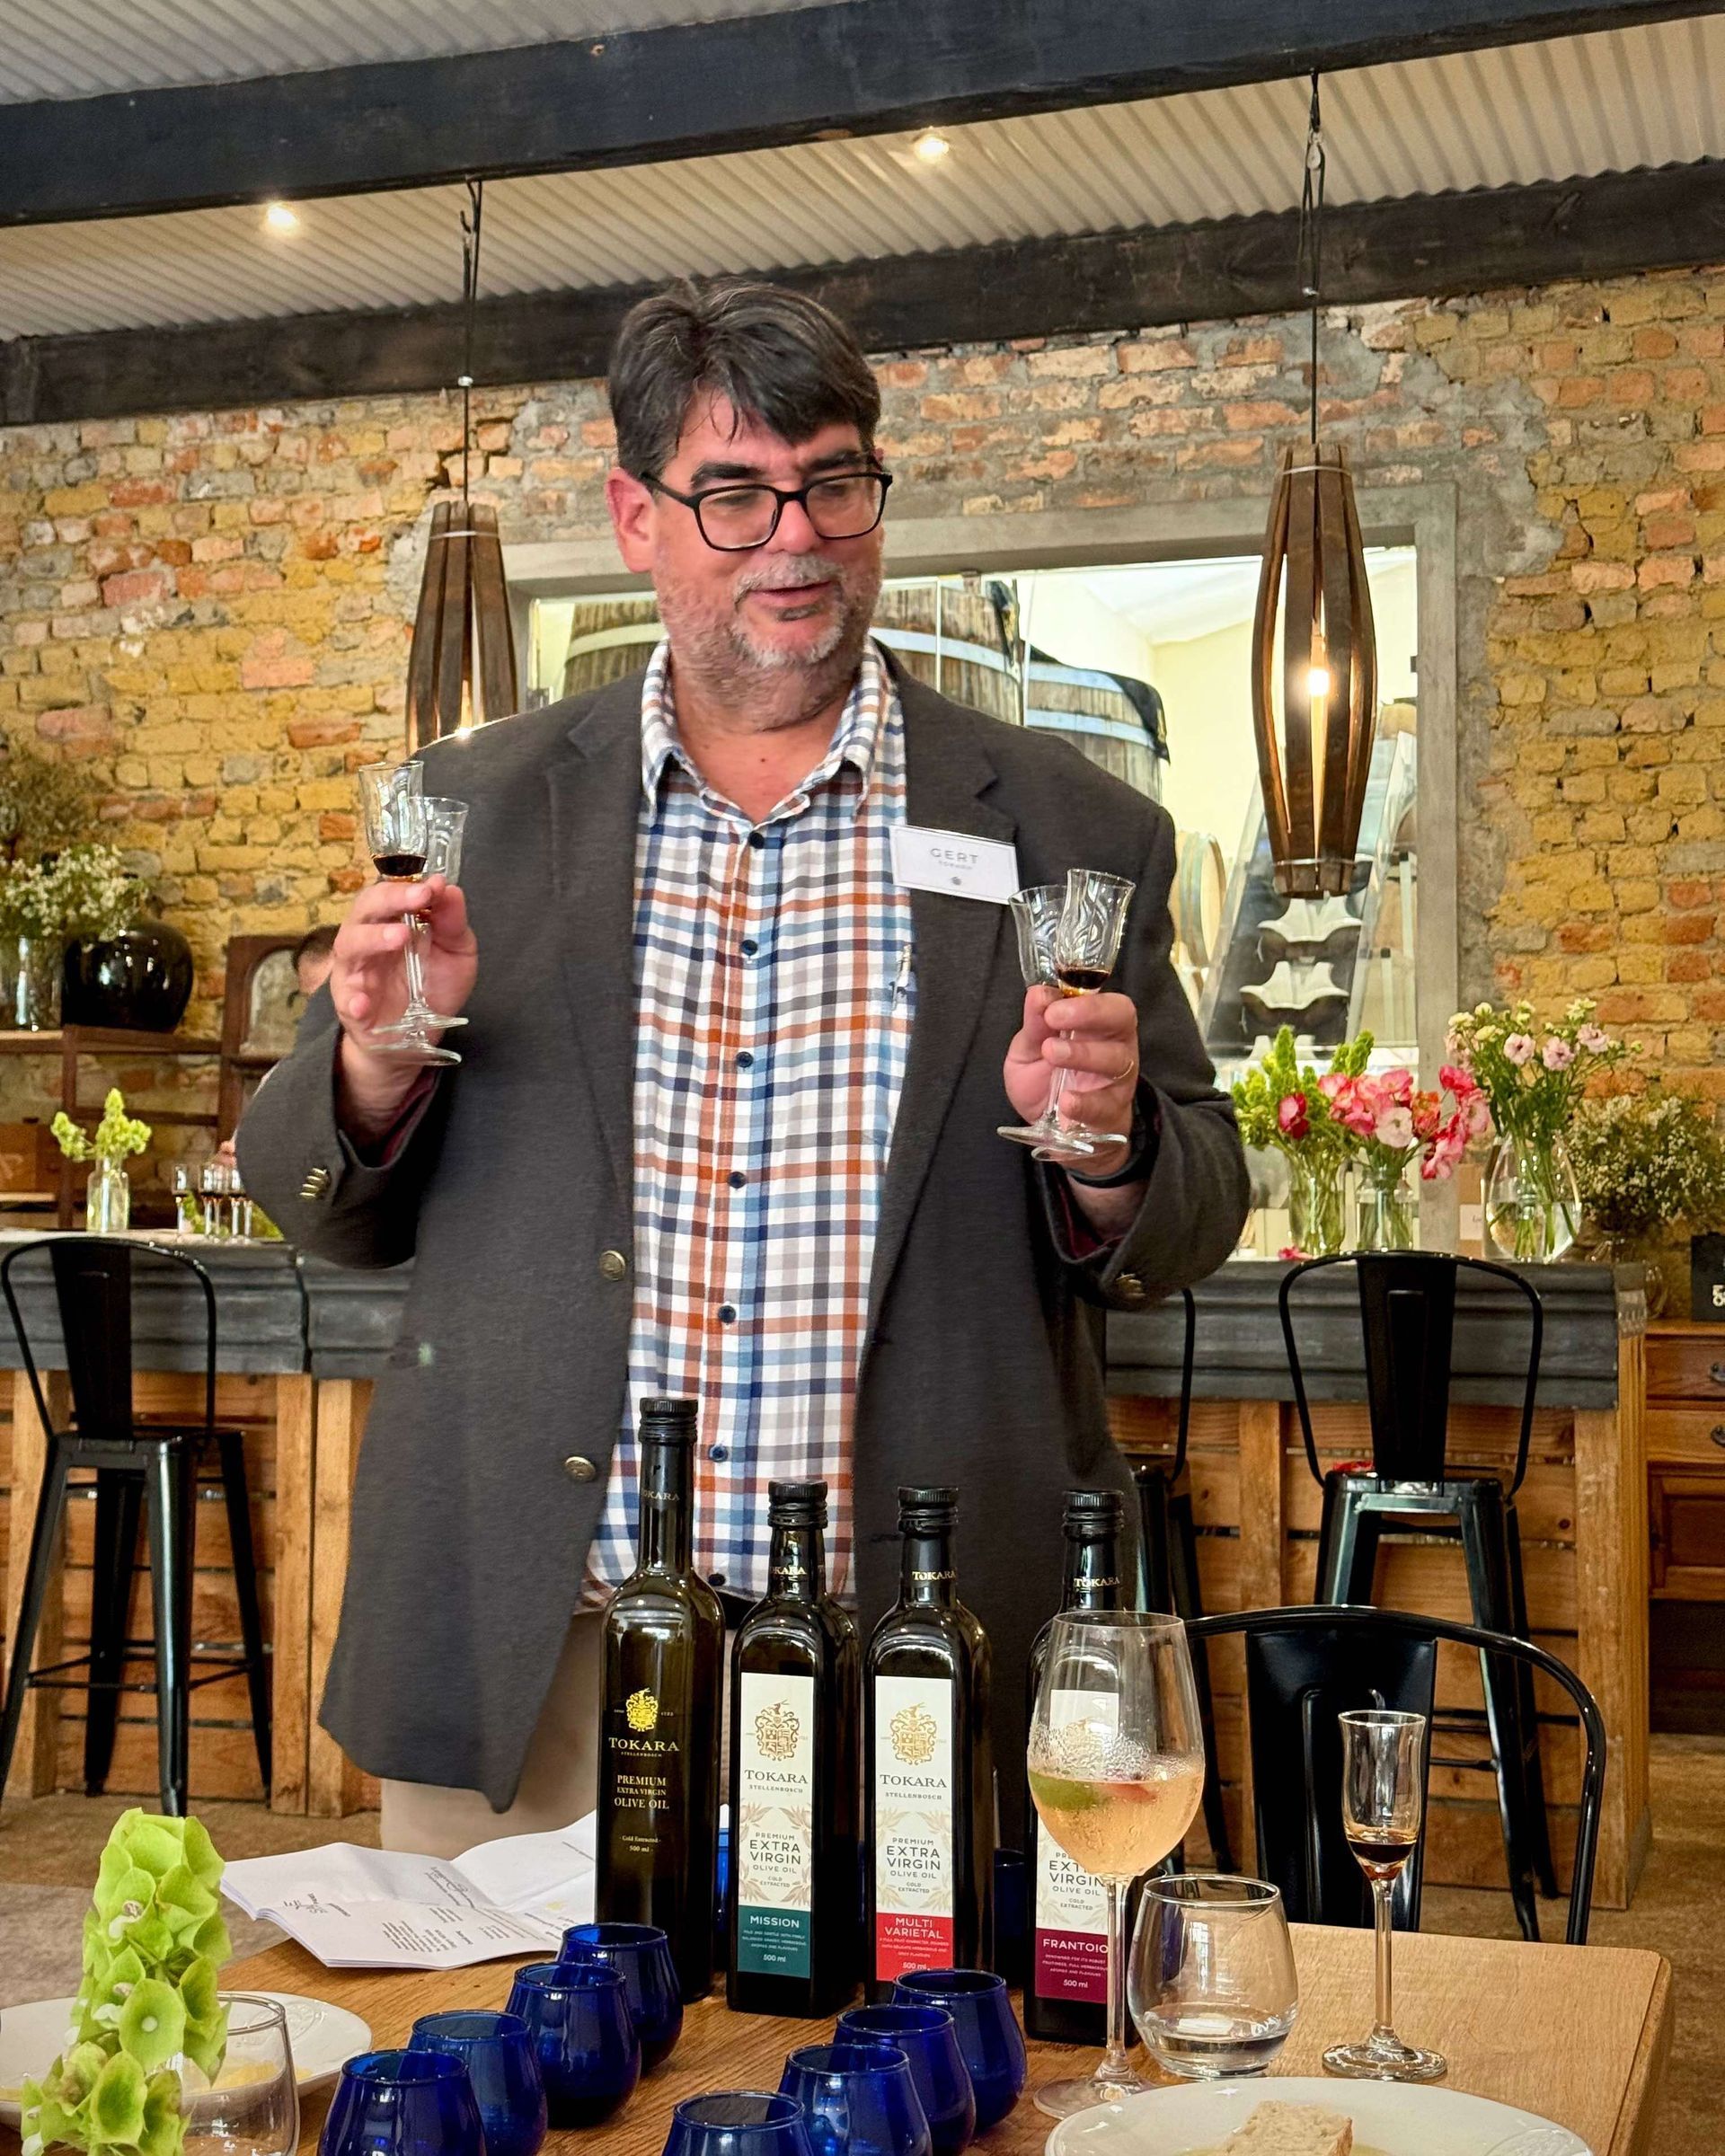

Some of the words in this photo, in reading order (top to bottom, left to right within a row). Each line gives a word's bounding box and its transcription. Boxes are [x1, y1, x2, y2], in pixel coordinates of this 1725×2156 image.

[930, 848, 978, 863] GERT
[641, 1488, 680, 1500] OKARA
[771, 1566, 807, 1576] KARA
[912, 1570, 957, 1581] TOKARA
[1074, 1577, 1120, 1587] TOKARA
[608, 1737, 680, 1752] TOKARA
[617, 1774, 667, 1787] PREMIUM
[744, 1769, 809, 1784] TOKARA
[880, 1774, 947, 1788] TOKARA
[616, 1787, 639, 1795] EXTRA
[640, 1788, 667, 1796] VIRGIN
[748, 1784, 803, 1794] STELLENBOSCH
[885, 1791, 942, 1800] STELLENBOSCH
[614, 1797, 646, 1808] OLIVE
[648, 1798, 670, 1809] OIL
[756, 1832, 795, 1841] PREMIUM
[892, 1837, 934, 1846] PREMIUM
[749, 1839, 801, 1853] EXTRA
[886, 1845, 941, 1859] EXTRA
[749, 1851, 801, 1865] VIRGIN
[887, 1857, 941, 1870] VIRGIN
[753, 1864, 780, 1872] OLIVE
[782, 1867, 797, 1875] OIL
[1049, 1860, 1086, 1873] EXT
[890, 1870, 918, 1878] OLIVE
[1049, 1872, 1106, 1886] VIRGIN
[1052, 1886, 1081, 1895] OLIVE
[1060, 1903, 1093, 1911] EXTRACTED
[749, 1915, 800, 1929] MISSION
[895, 1917, 933, 1928] MULTI
[884, 1926, 944, 1940] VARIETAL
[1042, 1939, 1109, 1954] FRANTOIO
[1063, 1979, 1077, 1987] 500
